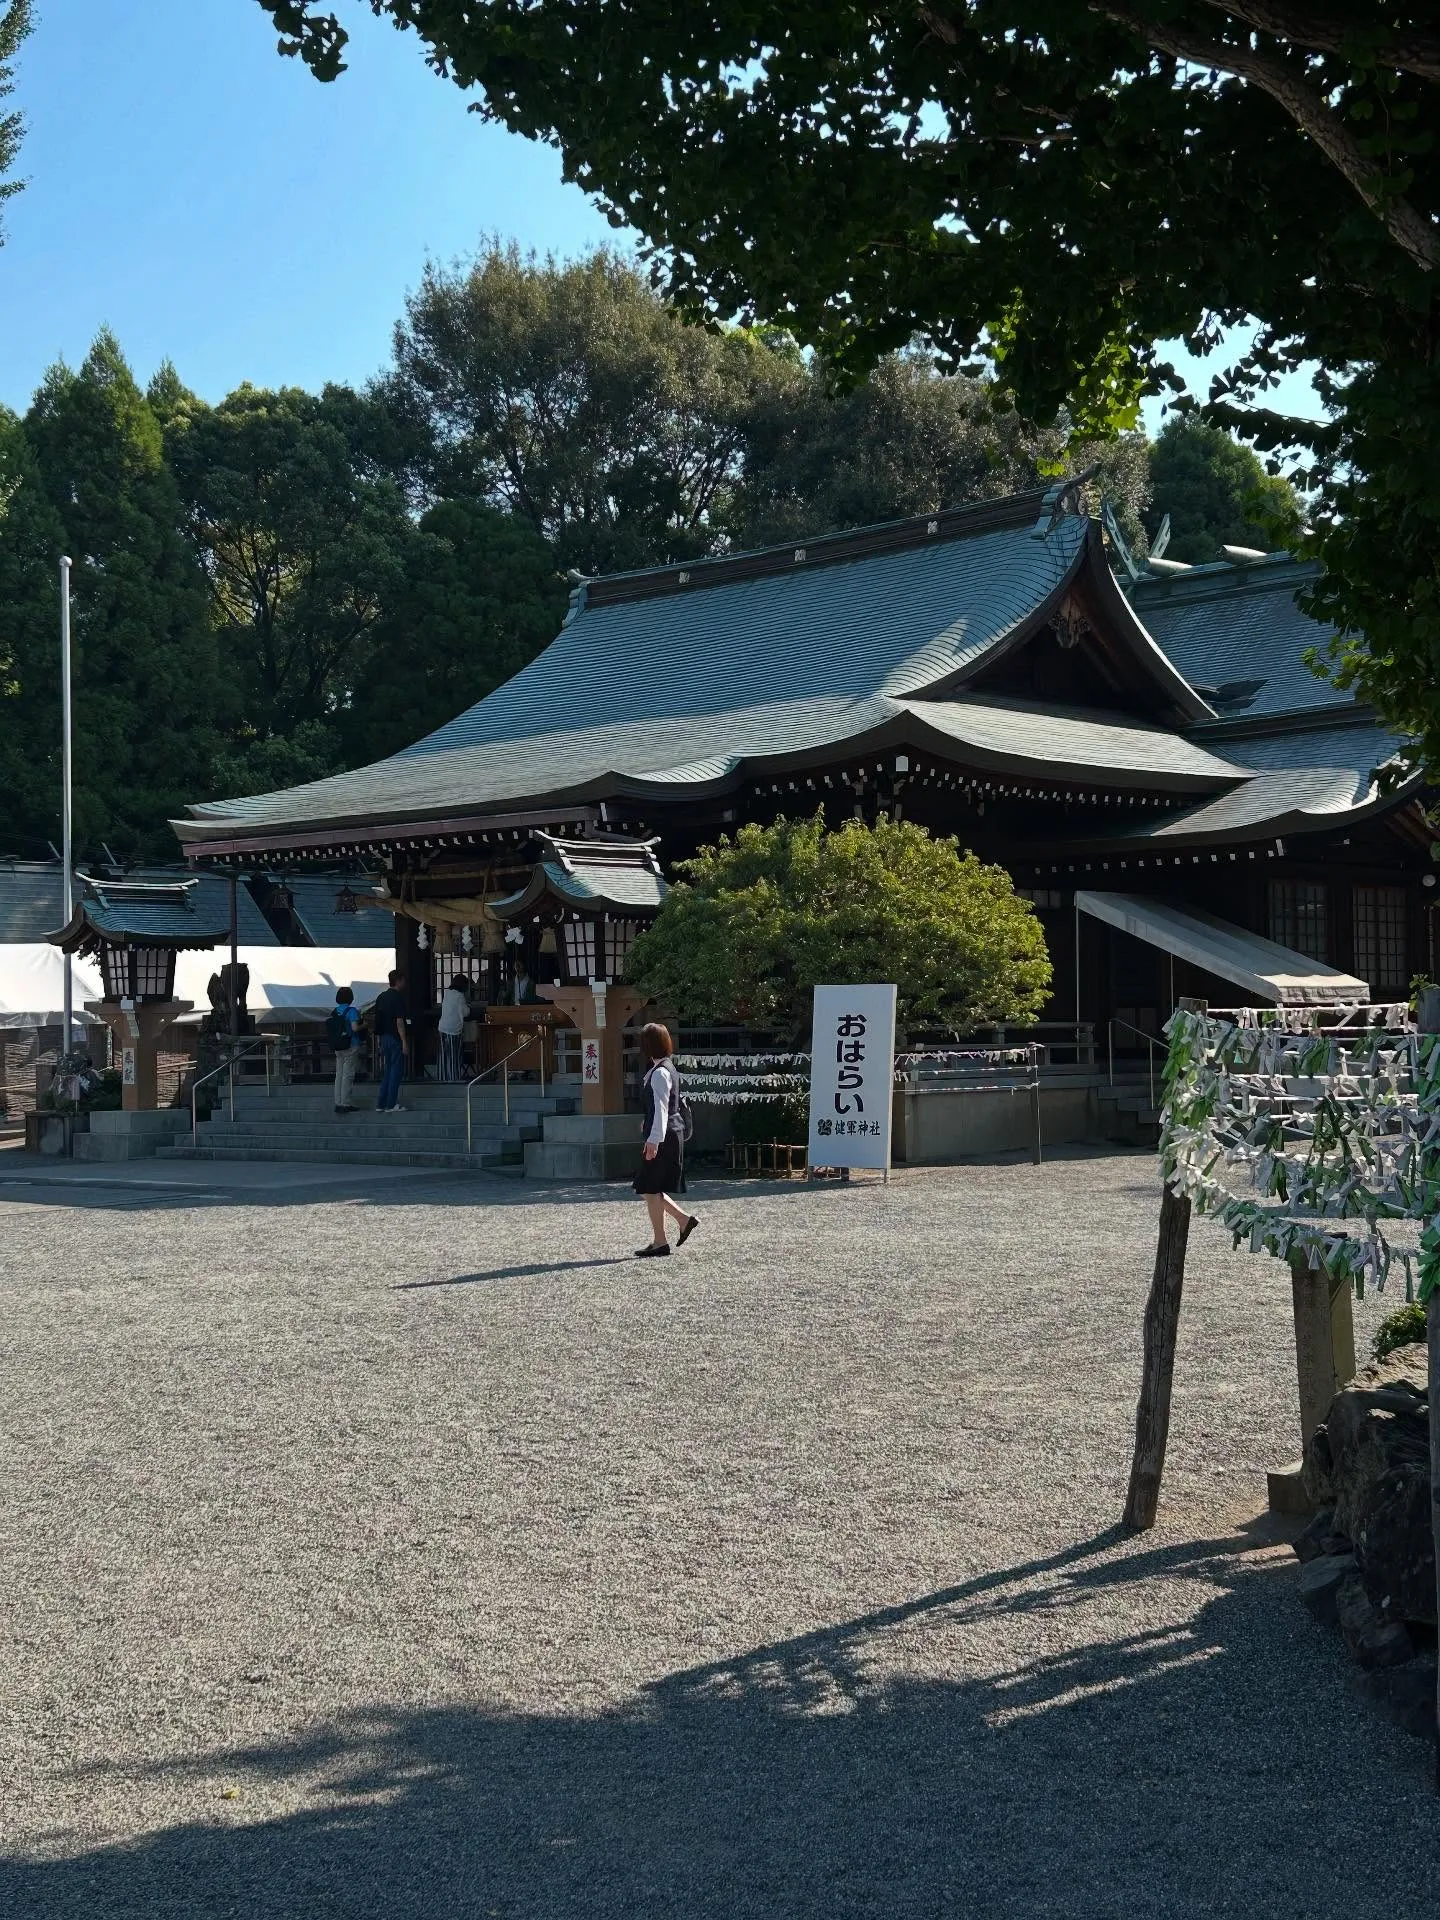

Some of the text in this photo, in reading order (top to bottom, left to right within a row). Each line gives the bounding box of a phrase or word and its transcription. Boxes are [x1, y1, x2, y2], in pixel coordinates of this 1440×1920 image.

[585, 1043, 598, 1080] 奉献
[834, 1014, 867, 1114] おはらい
[835, 1119, 881, 1136] 健軍神社
